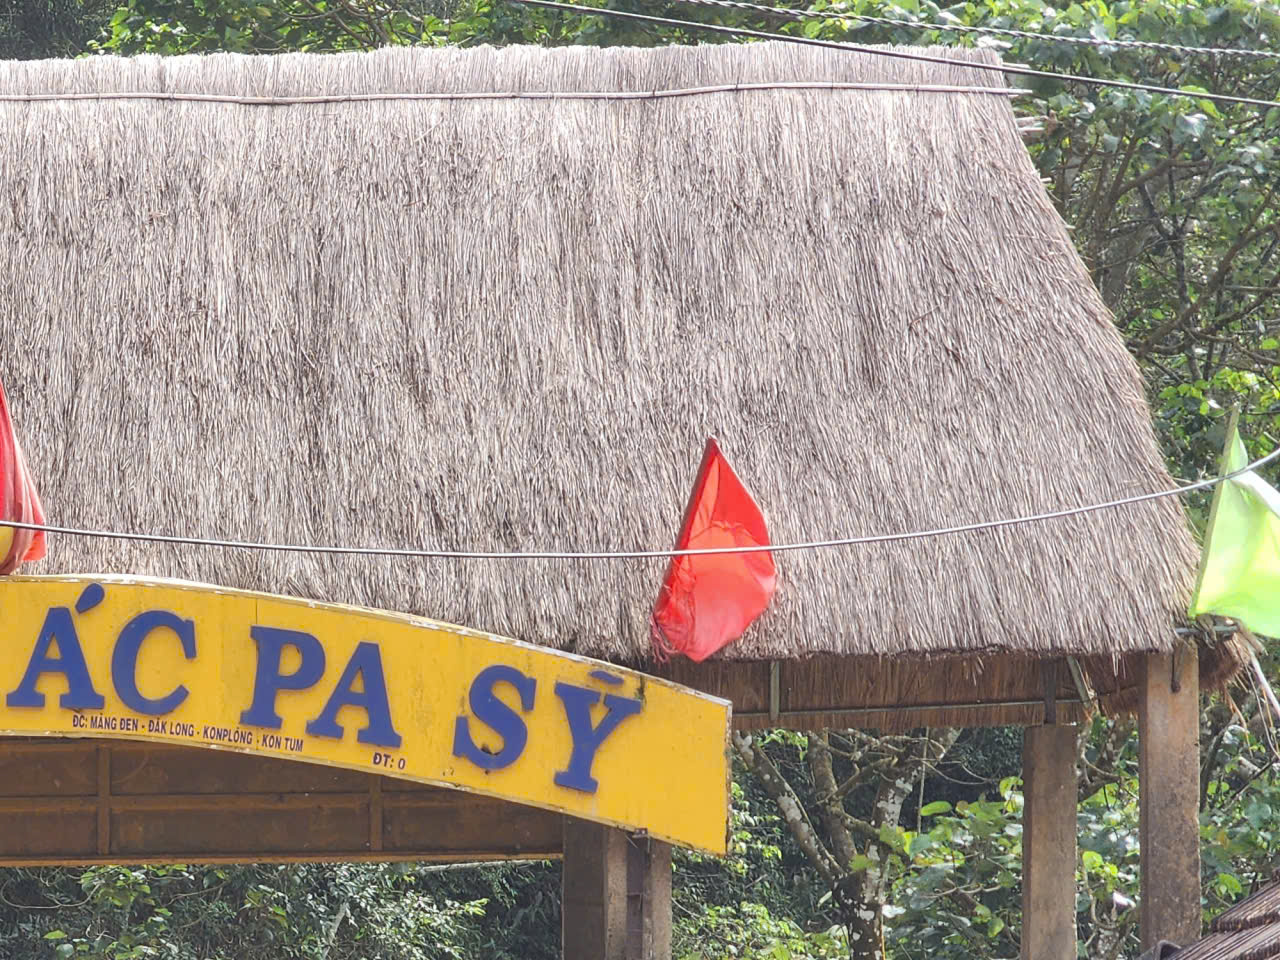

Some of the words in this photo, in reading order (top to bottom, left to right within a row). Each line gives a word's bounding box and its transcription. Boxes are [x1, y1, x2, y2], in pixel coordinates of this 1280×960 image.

[239, 625, 402, 748] PA
[454, 665, 643, 794] SỸ
[119, 717, 139, 732] ĐEN
[169, 721, 195, 737] LONG
[261, 734, 281, 749] KON
[284, 737, 304, 752] TUM
[373, 751, 394, 769] ĐT:
